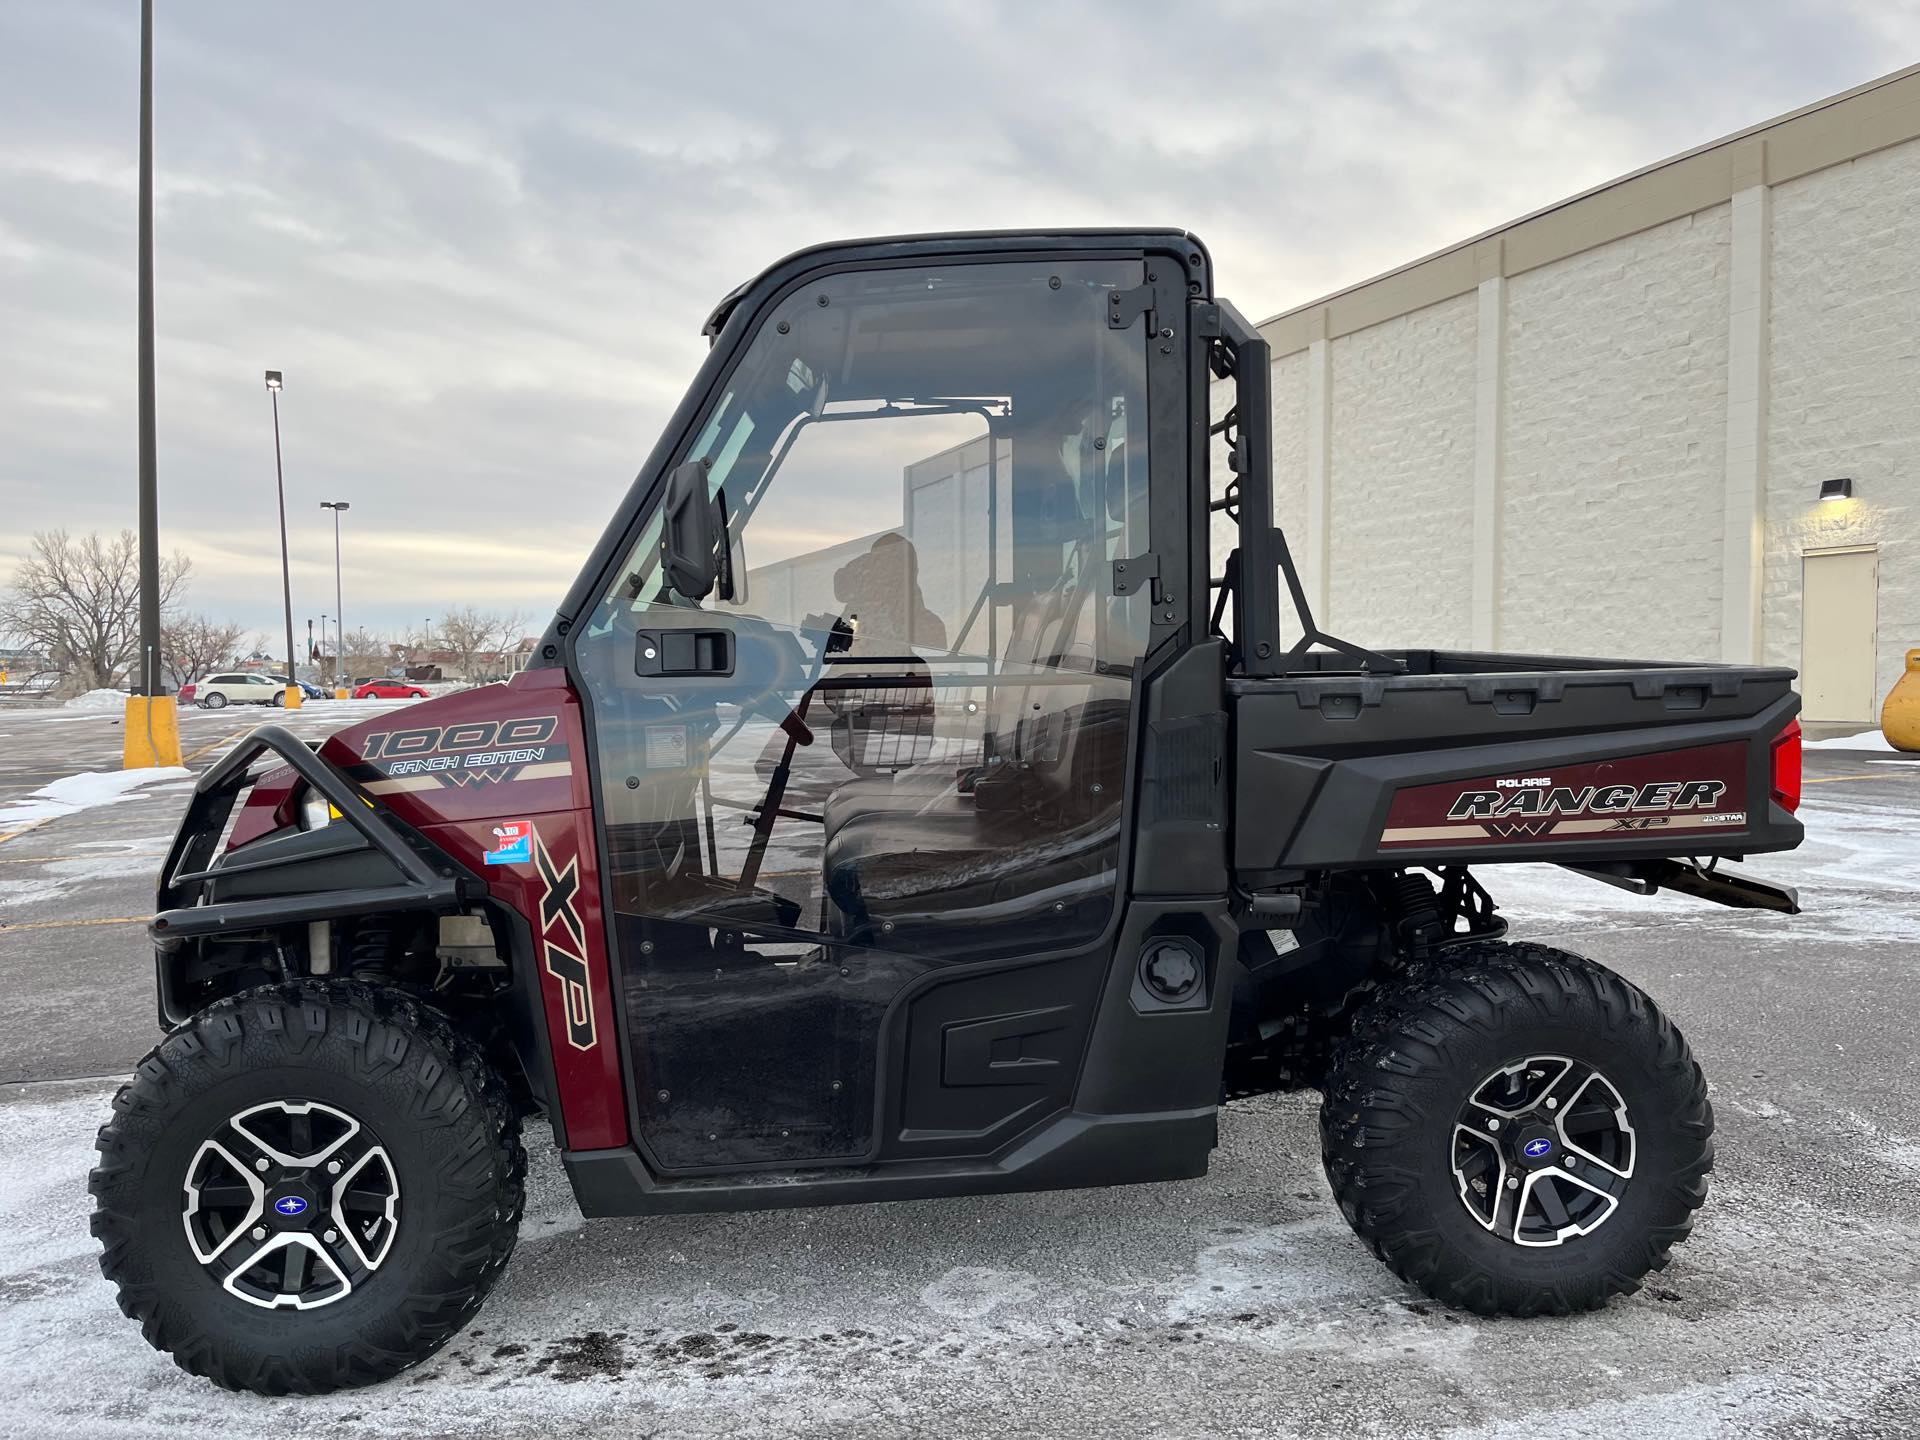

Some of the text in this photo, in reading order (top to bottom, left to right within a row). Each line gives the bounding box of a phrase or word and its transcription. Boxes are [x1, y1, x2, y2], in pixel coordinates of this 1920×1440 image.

[361, 715, 558, 761] 1000
[389, 748, 544, 775] RANCH EDITION
[1496, 777, 1551, 788] POLARIS
[1446, 780, 1726, 819] RANGER
[1604, 816, 1671, 831] XP
[531, 822, 597, 1051] XP
